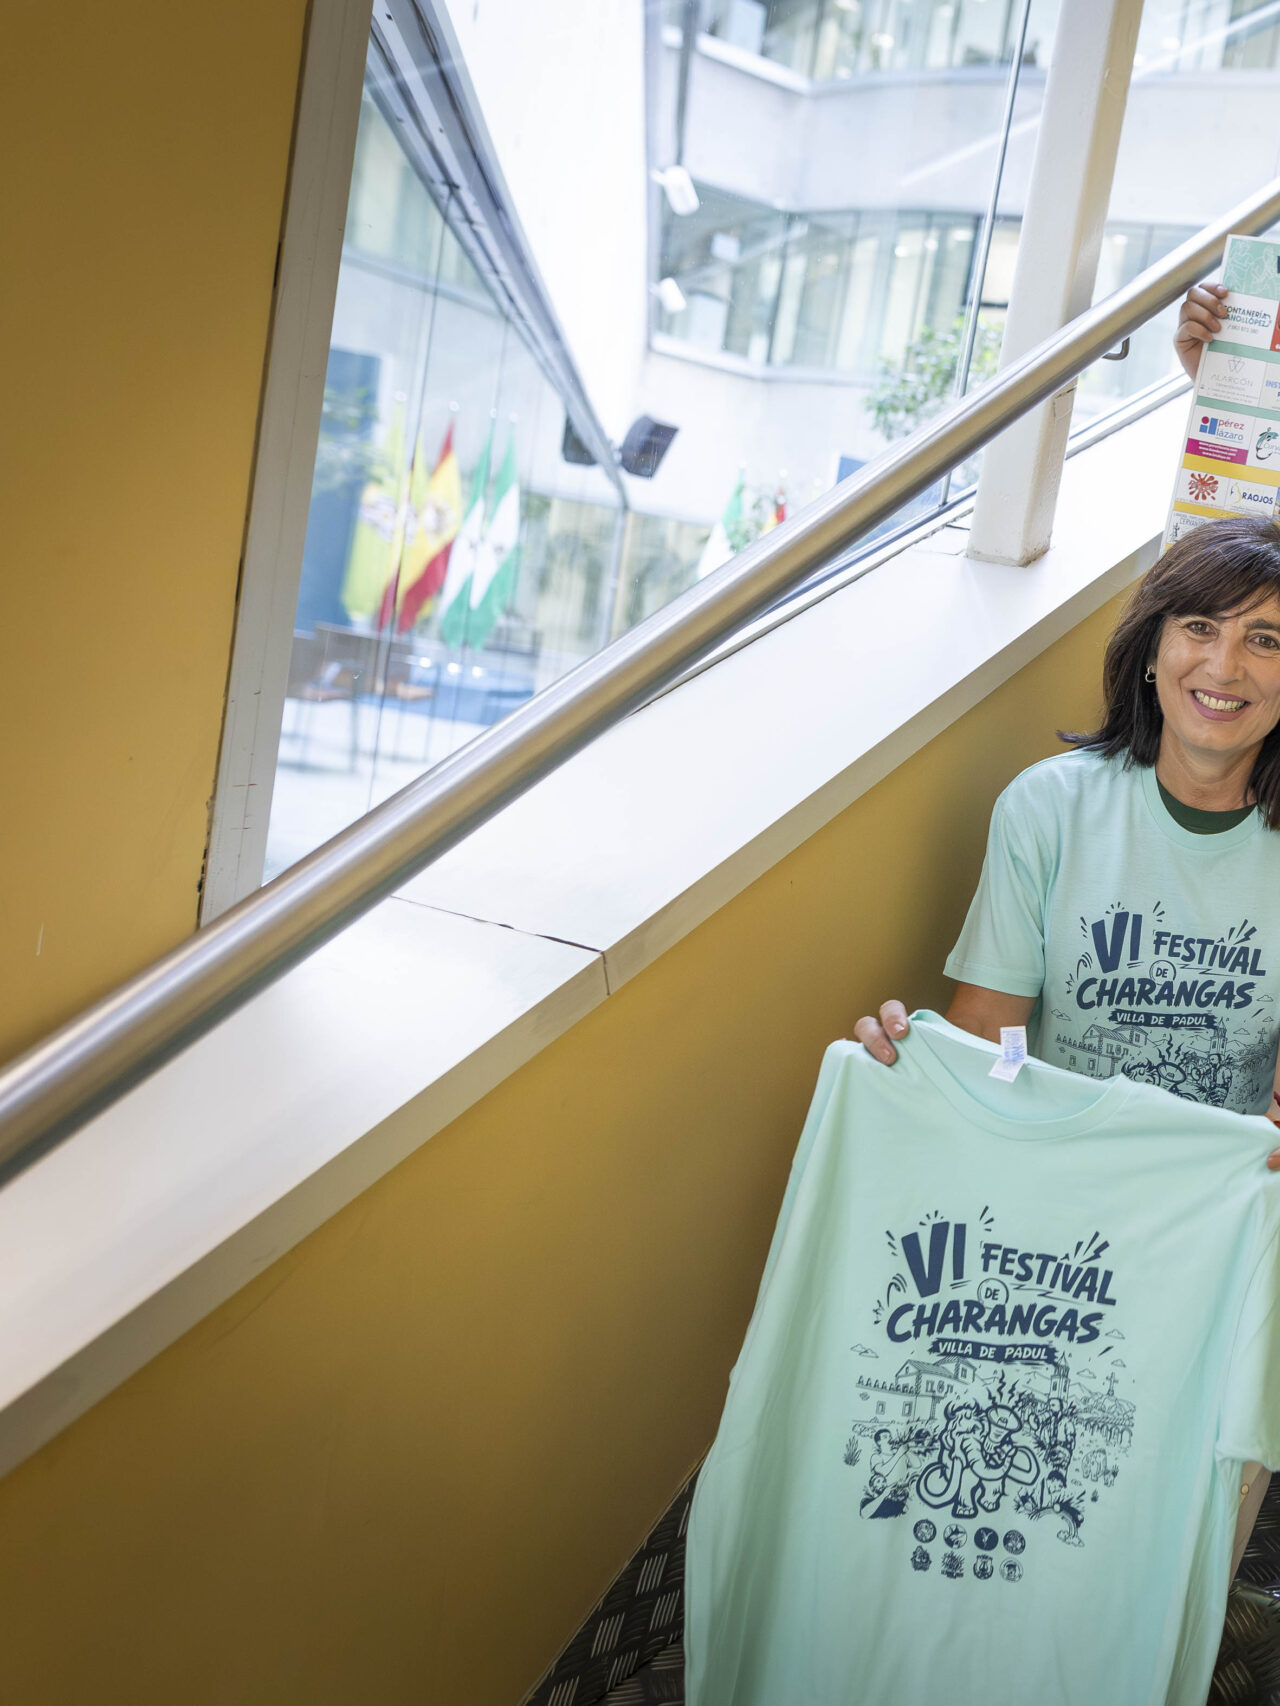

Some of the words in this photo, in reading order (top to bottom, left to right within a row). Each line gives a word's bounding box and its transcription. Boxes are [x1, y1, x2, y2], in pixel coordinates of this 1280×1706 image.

[1218, 419, 1245, 431] pérez
[1216, 430, 1244, 441] lázaro
[1091, 911, 1143, 974] VI
[1153, 930, 1266, 977] FESTIVAL
[1155, 967, 1168, 978] DE
[1076, 977, 1257, 1010] CHARANGAS
[1116, 1012, 1145, 1024] VILLA
[1150, 1014, 1164, 1026] DE
[1172, 1016, 1208, 1026] PADUL
[901, 1221, 968, 1298] VI
[980, 1242, 1117, 1306] FESTIVAL
[984, 1288, 1000, 1301] DE
[886, 1300, 1106, 1344] CHARANGAS
[938, 1342, 973, 1356] VILLA
[979, 1346, 997, 1359] DE
[1004, 1346, 1048, 1360] PADUL
